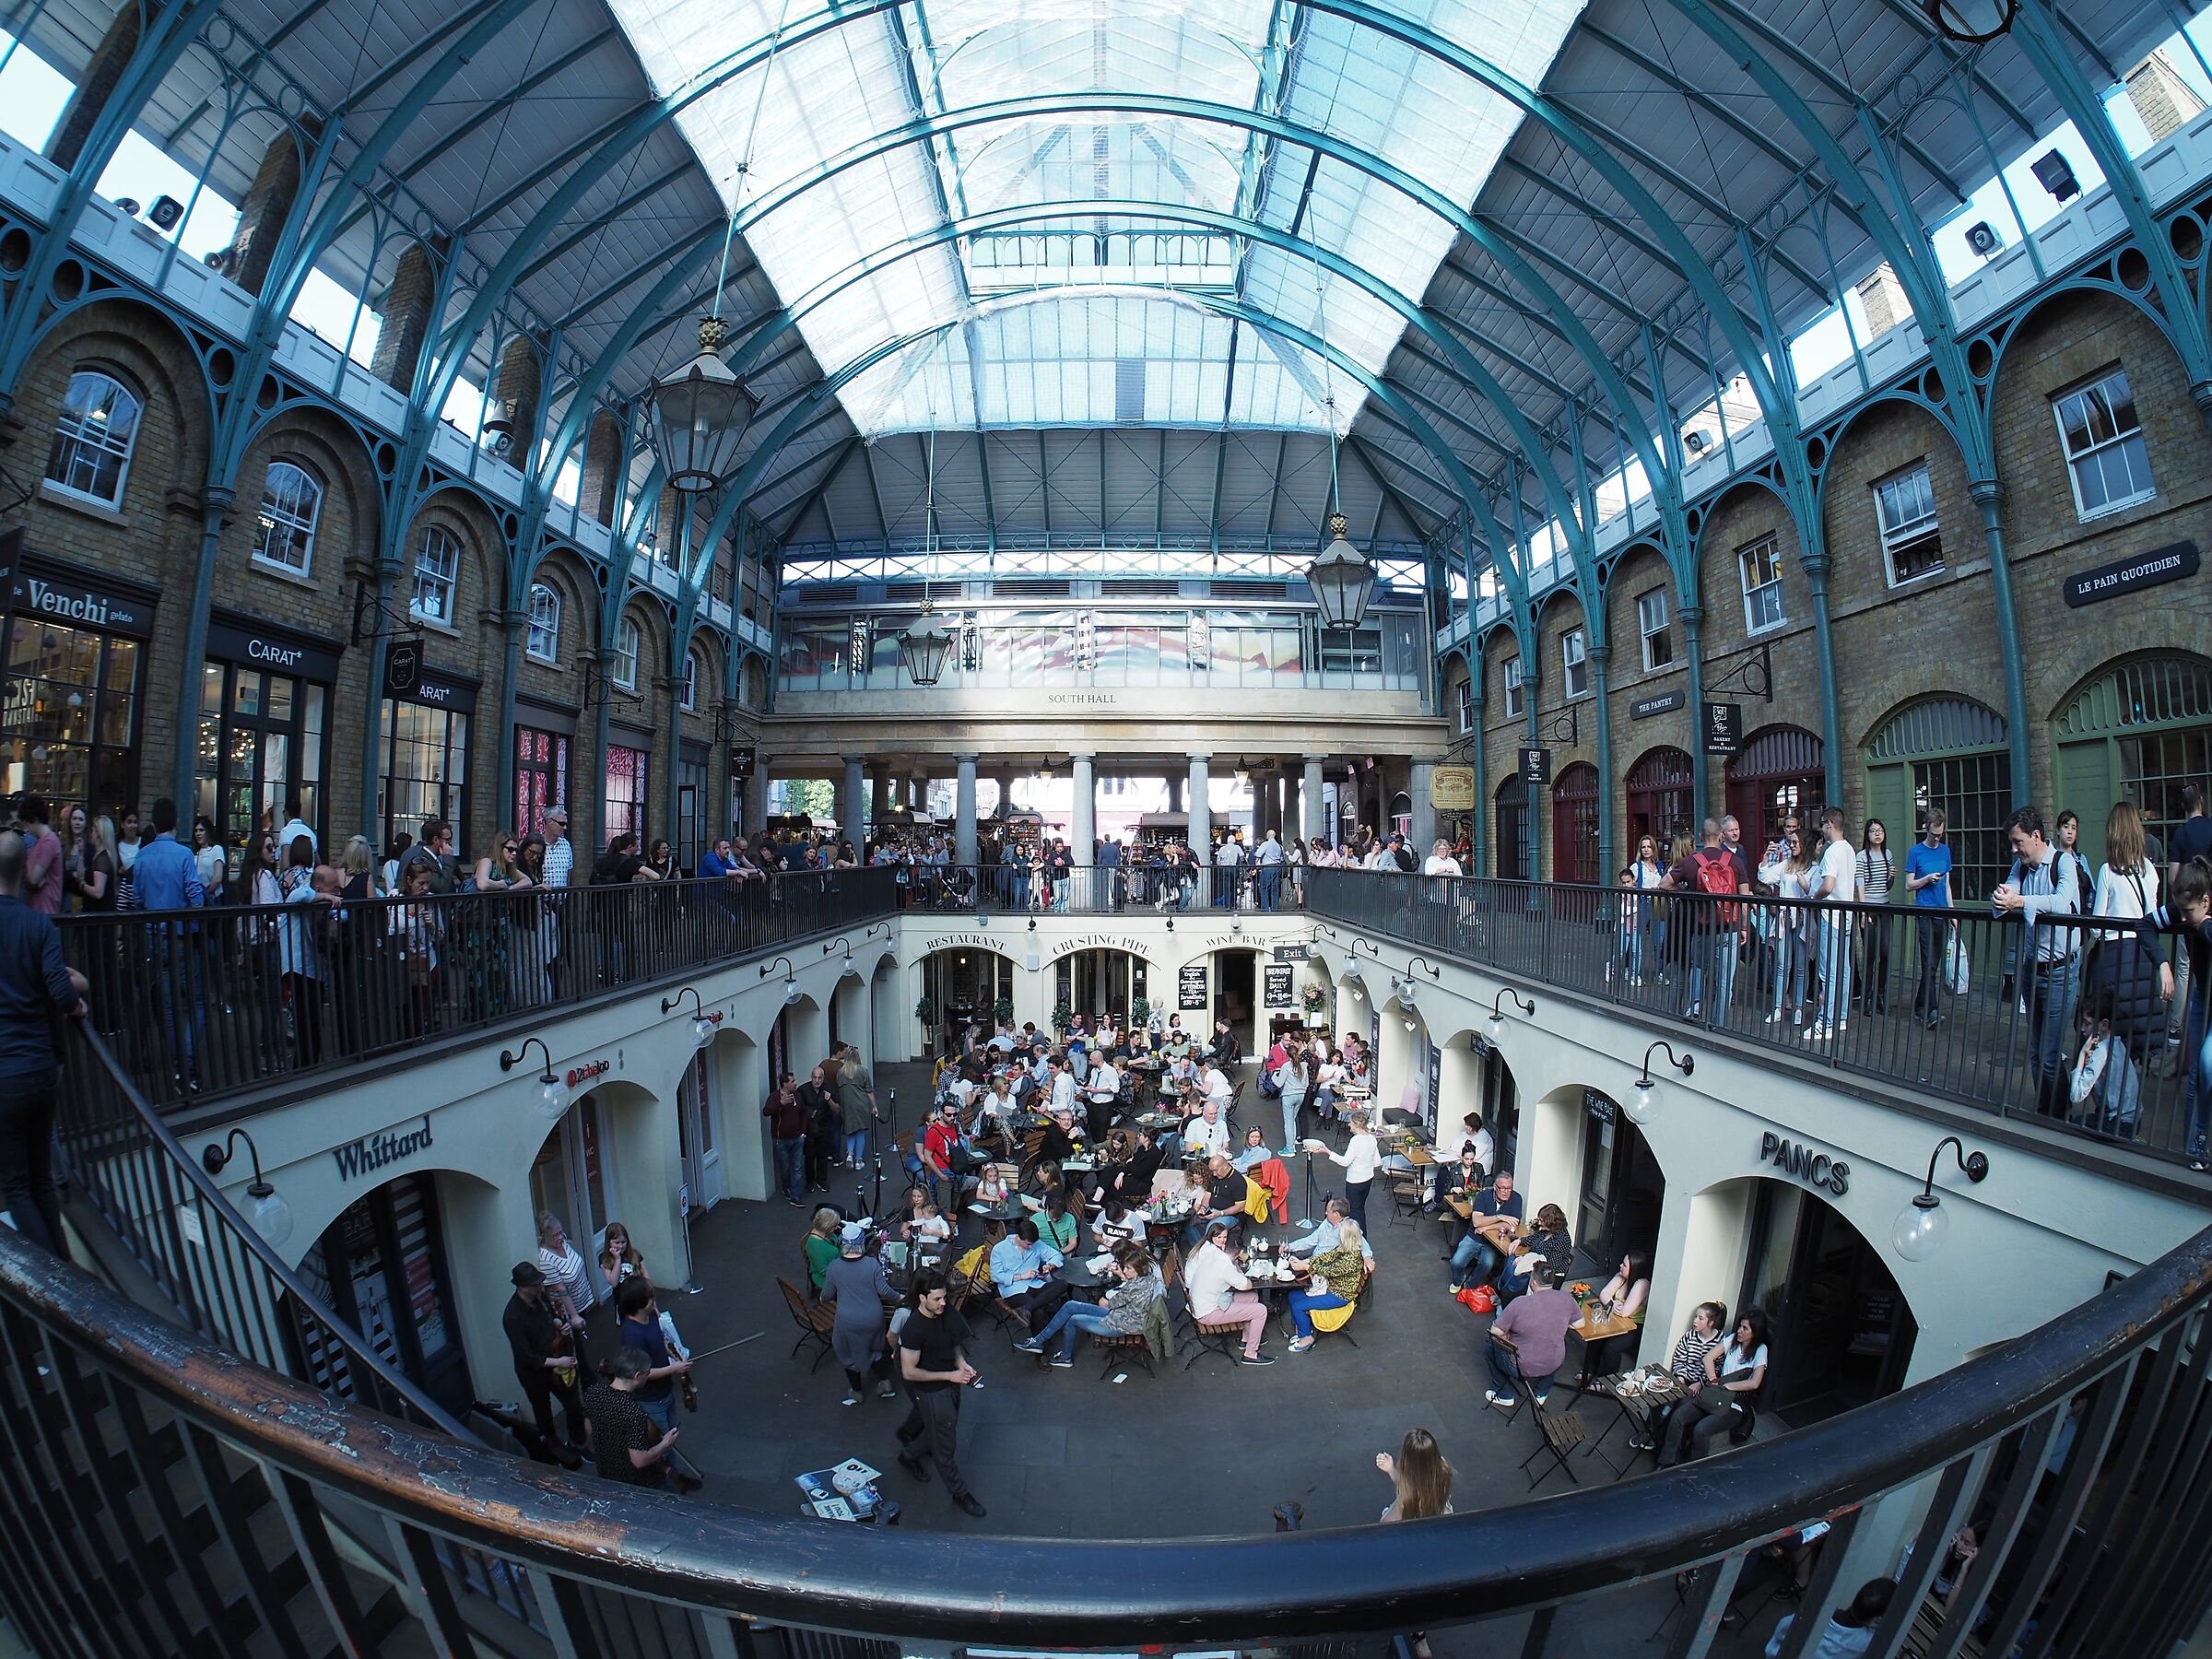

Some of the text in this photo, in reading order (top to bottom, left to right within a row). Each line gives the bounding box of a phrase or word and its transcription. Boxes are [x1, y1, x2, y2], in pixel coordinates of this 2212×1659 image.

[2077, 555, 2181, 594] LE PAIN QUOTIDIEN
[28, 579, 108, 625] Venchi
[111, 610, 133, 623] gelato
[1048, 695, 1117, 703] SOUTH HALL
[1639, 697, 1672, 712] THE PANTRY
[926, 934, 1007, 952] RESTAURANT
[1053, 934, 1152, 957] CRUSTING PIPE
[1206, 935, 1266, 947] WINE BAR
[1283, 949, 1301, 959] Exit
[333, 1115, 433, 1182] Whittard
[1760, 1131, 1851, 1196] PANCS
